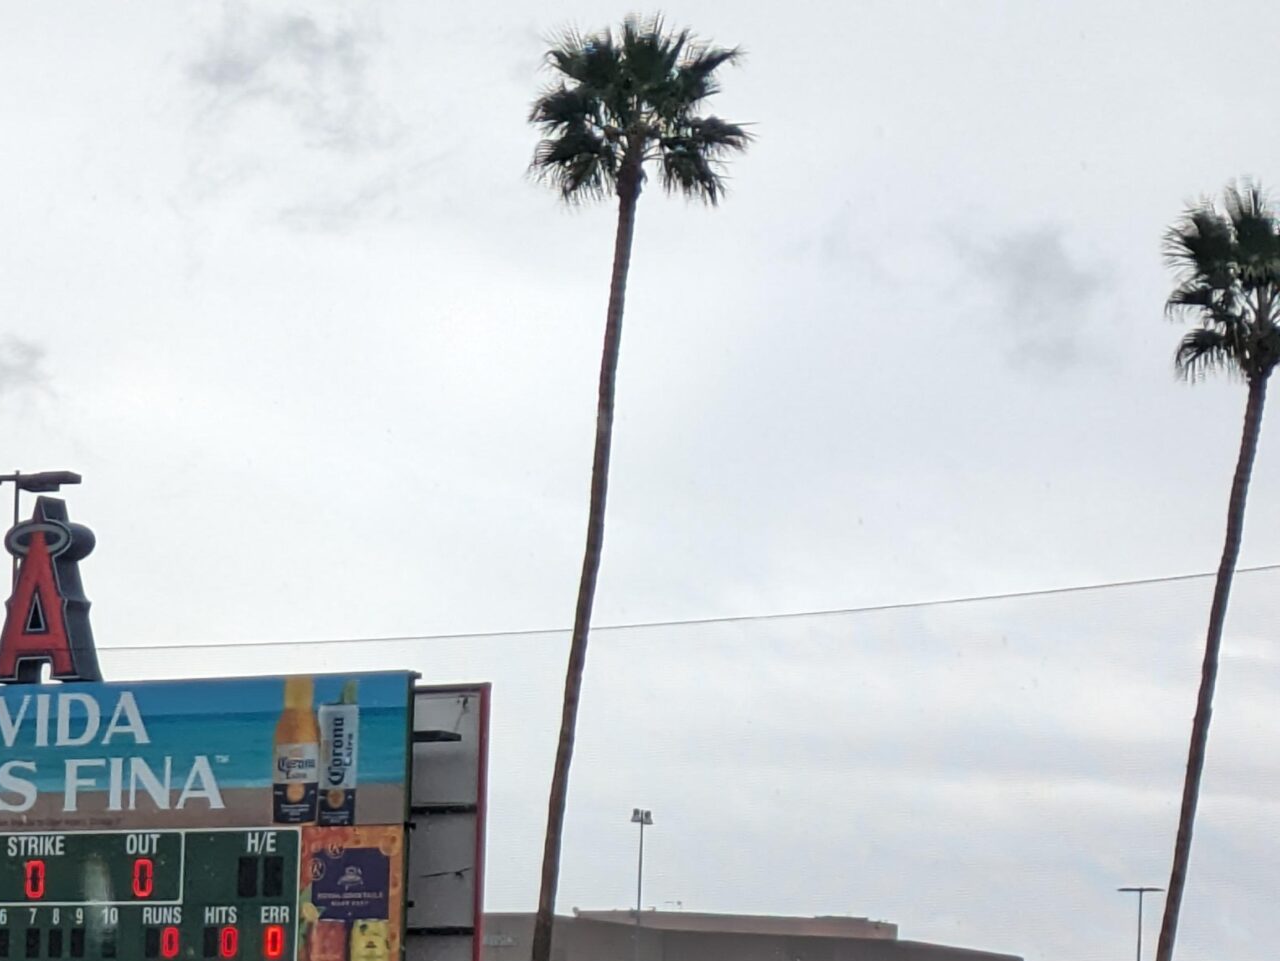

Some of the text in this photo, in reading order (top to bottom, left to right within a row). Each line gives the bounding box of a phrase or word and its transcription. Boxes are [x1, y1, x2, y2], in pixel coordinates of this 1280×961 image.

[328, 716, 344, 785] Corona
[7, 836, 65, 856] STRIKE
[126, 834, 160, 855] OUT
[246, 832, 277, 852] H/E
[25, 859, 45, 898] 0
[133, 858, 153, 897] 0
[0, 908, 7, 924] 6
[29, 908, 37, 923] 7
[53, 908, 60, 923] 8
[76, 908, 84, 924] 9
[102, 907, 118, 924] 10
[143, 907, 182, 924] RUNS
[205, 906, 238, 924] HITS
[260, 906, 289, 923] ERR
[161, 926, 179, 958] 0
[221, 926, 238, 958] 0
[265, 926, 283, 957] 0
